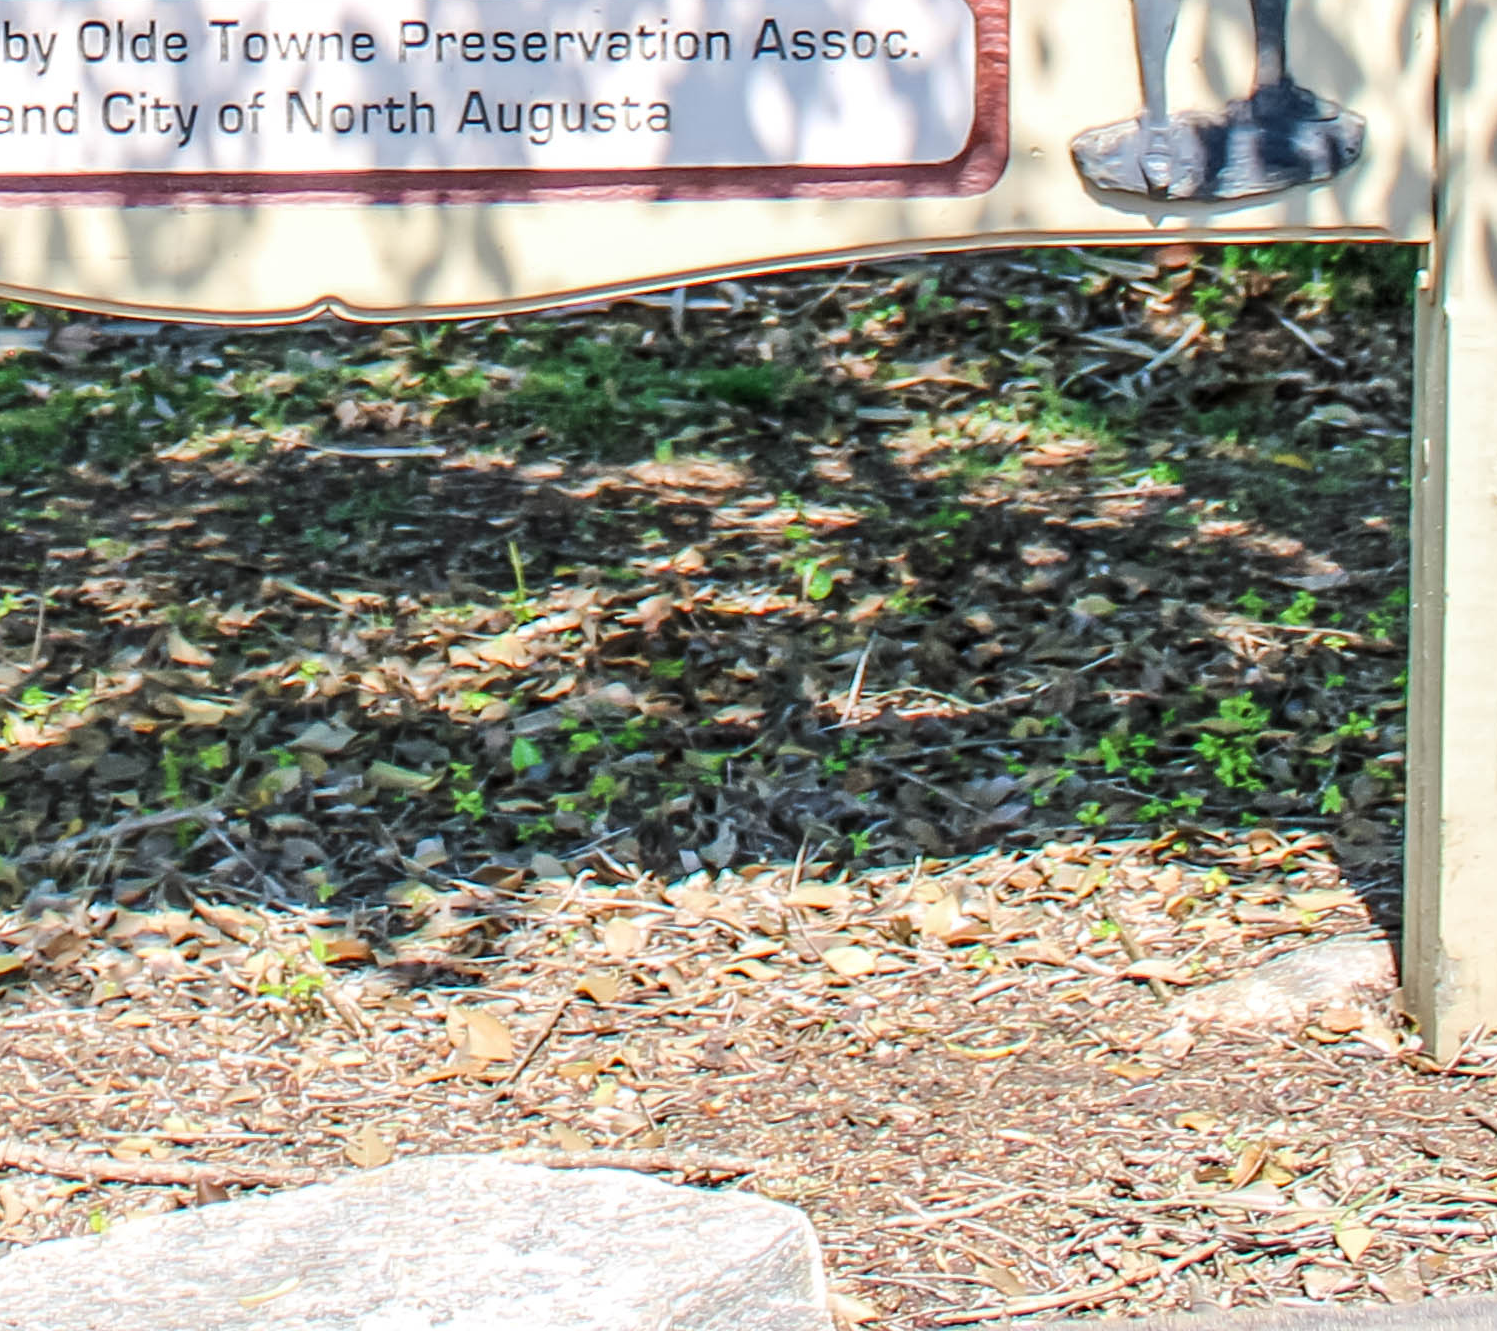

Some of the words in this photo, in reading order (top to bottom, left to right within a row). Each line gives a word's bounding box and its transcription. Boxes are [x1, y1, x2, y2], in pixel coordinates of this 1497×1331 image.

[1, 20, 58, 76] by
[76, 20, 189, 63] Olde
[209, 20, 377, 63] Towne
[399, 19, 732, 62] Preservation
[752, 17, 921, 61] Assoc.
[100, 91, 198, 146] City
[216, 91, 264, 135] of
[287, 91, 437, 135] North
[456, 91, 672, 144] Augusta
